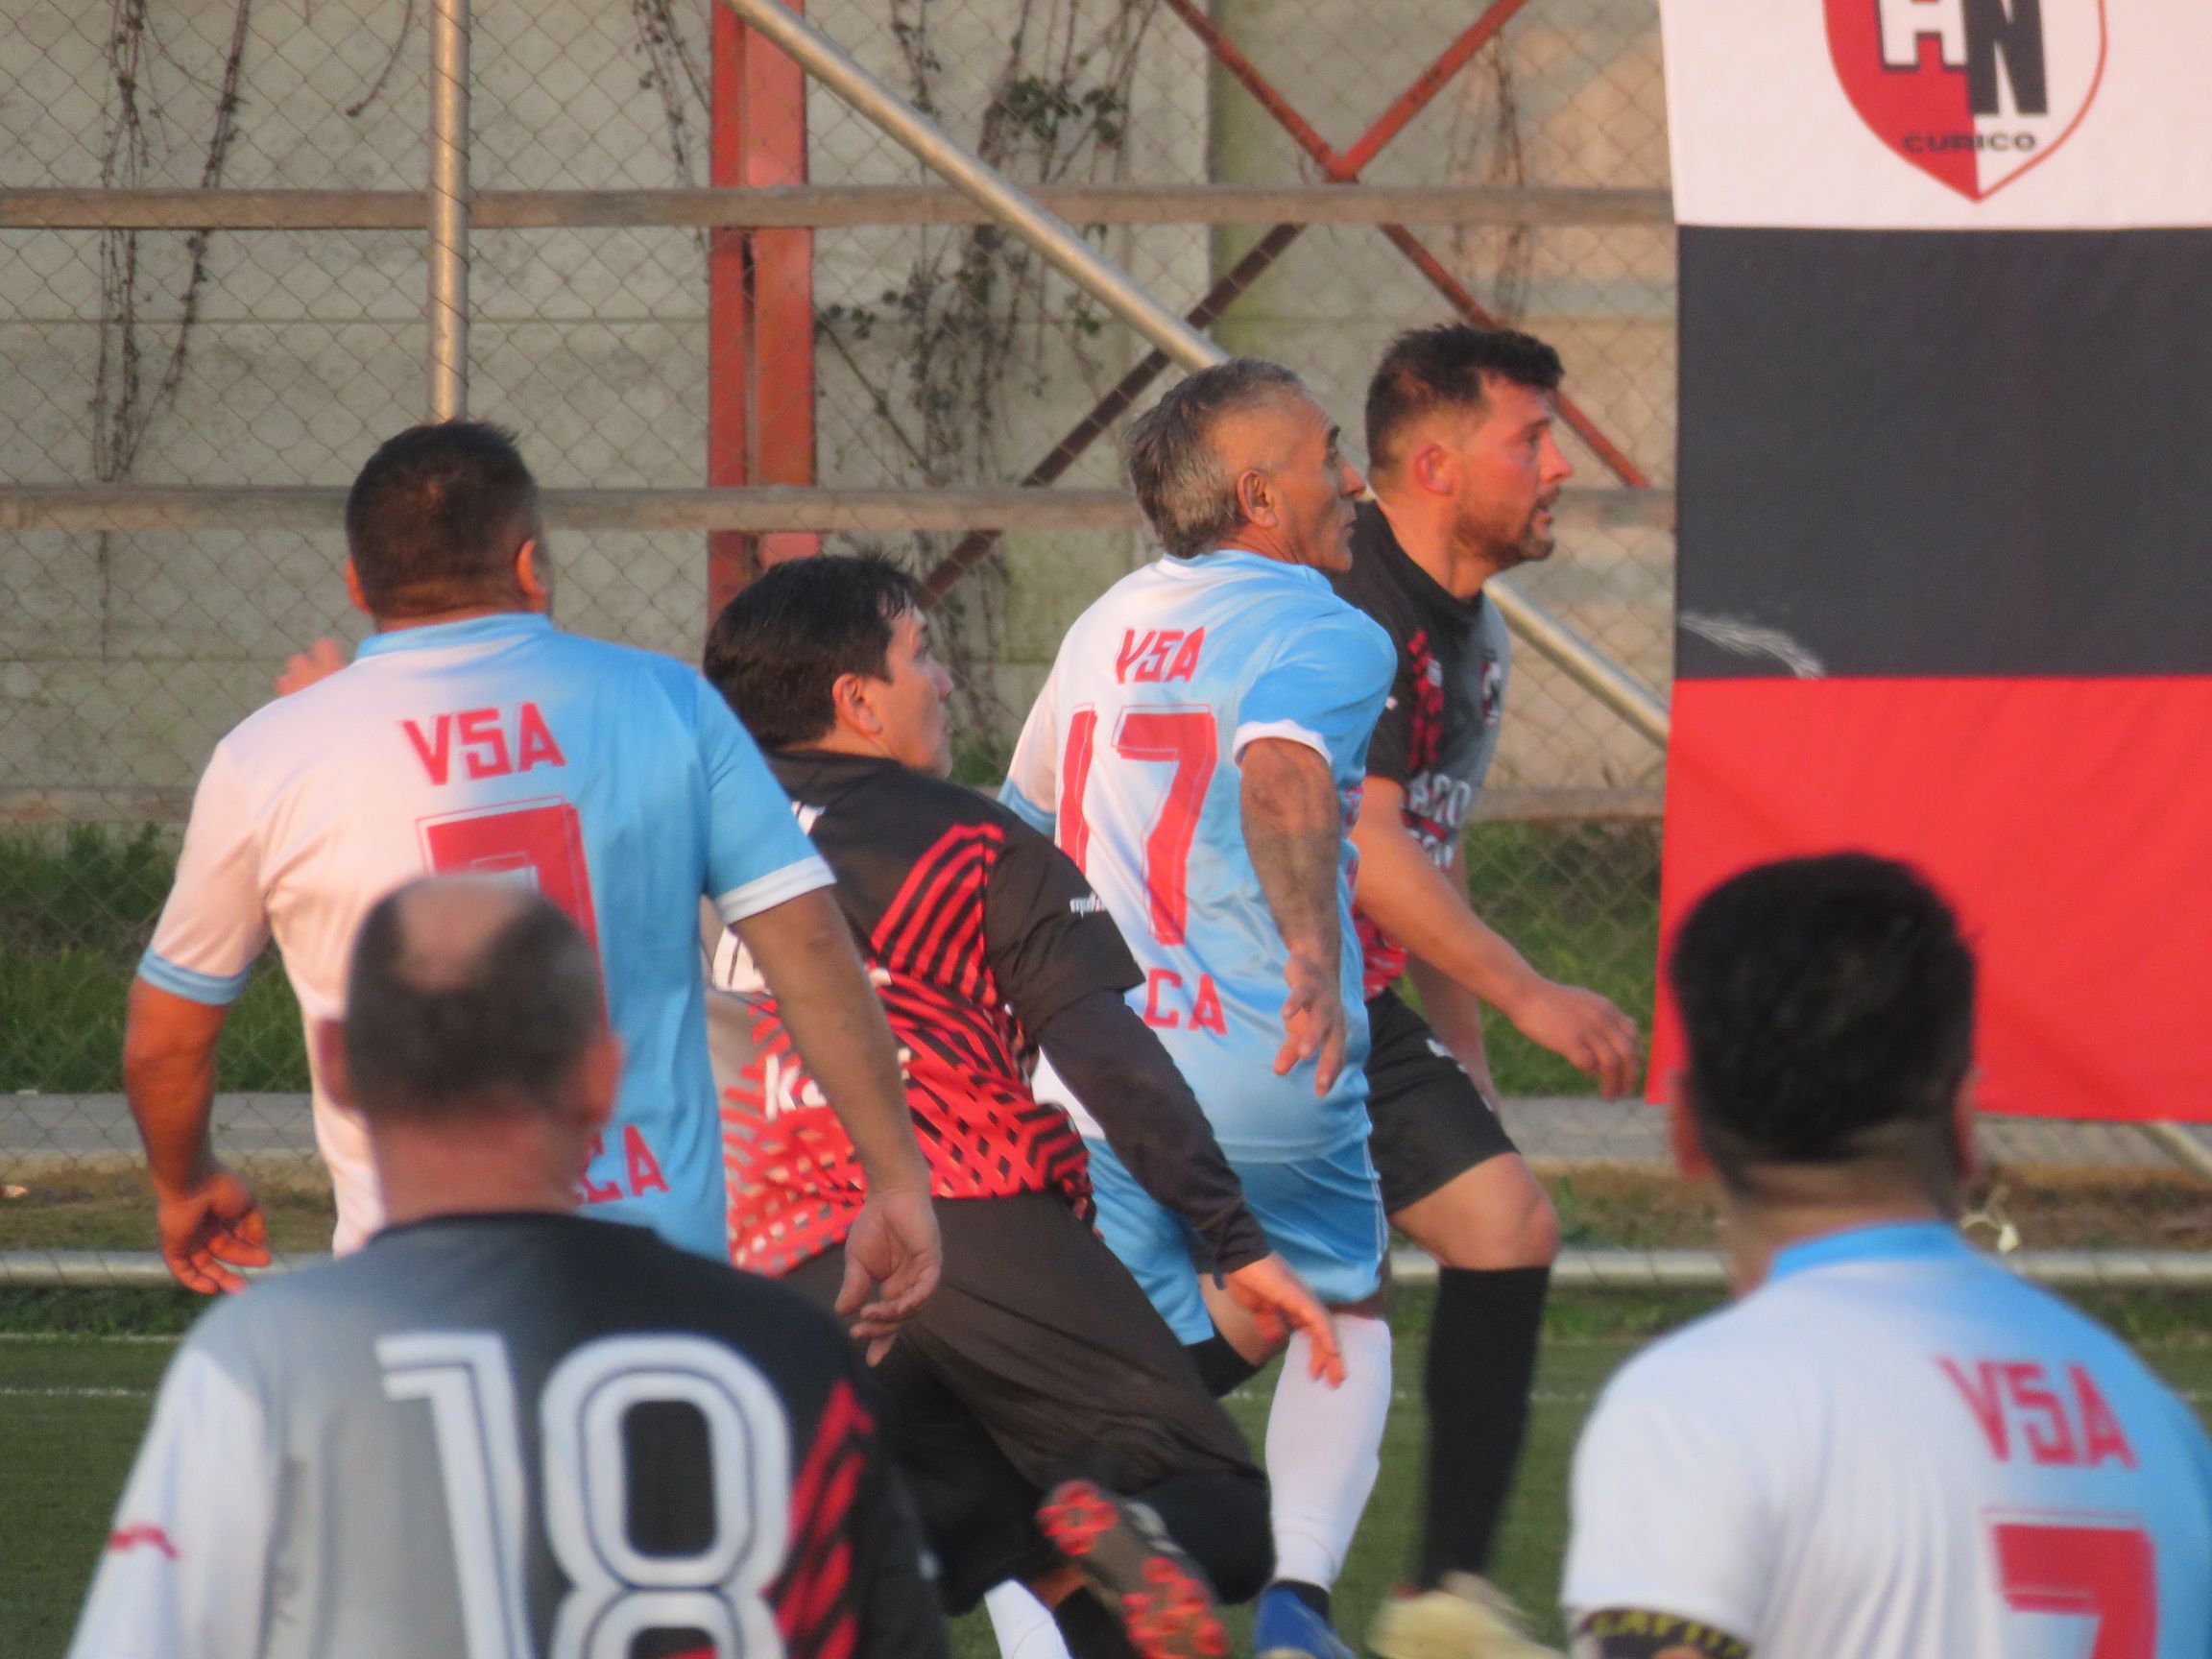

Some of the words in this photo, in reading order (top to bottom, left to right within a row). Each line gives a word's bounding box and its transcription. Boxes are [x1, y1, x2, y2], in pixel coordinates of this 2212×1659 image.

[1903, 132, 2036, 154] CURICO
[1115, 626, 1206, 685] VSA
[400, 701, 567, 786] VSA
[1058, 703, 1218, 947] 17
[1142, 967, 1228, 1037] CA
[575, 1123, 670, 1205] CA
[1935, 1356, 2139, 1471] VSA
[374, 1332, 793, 1659] 18
